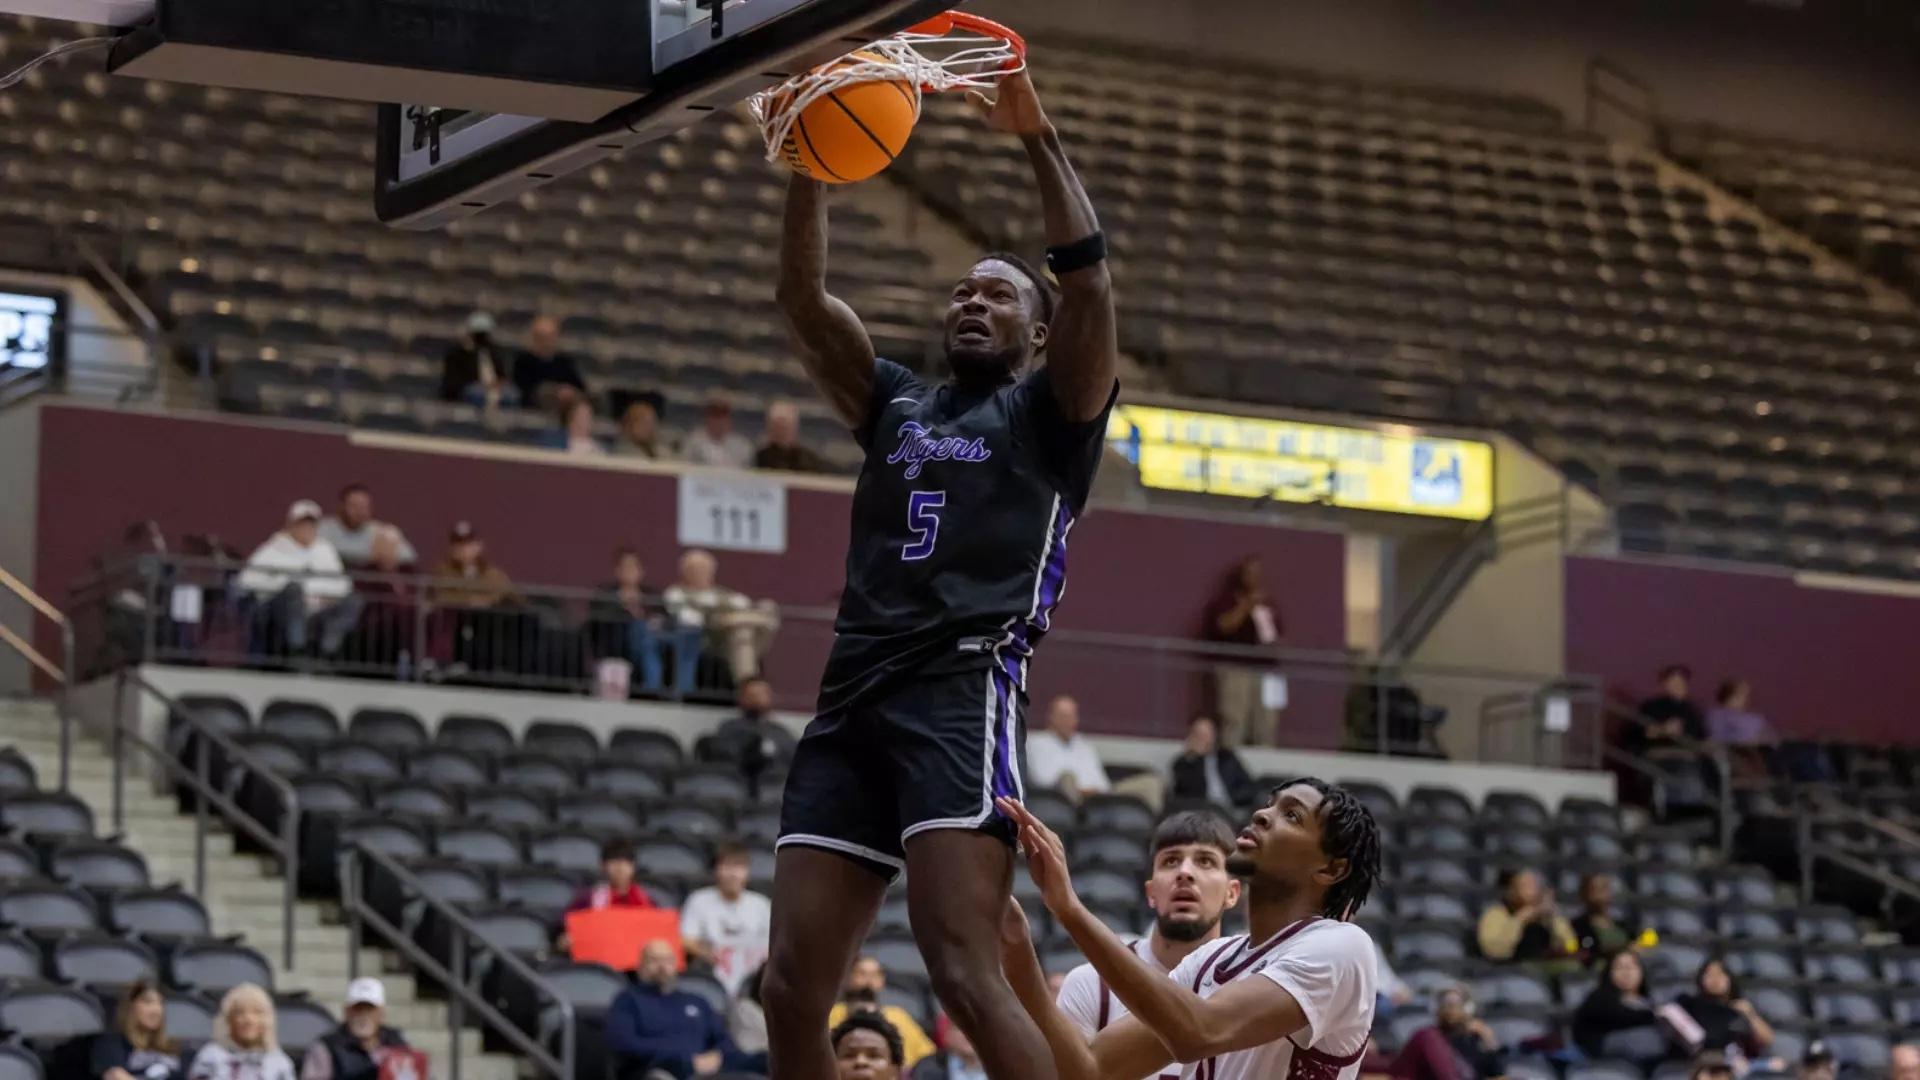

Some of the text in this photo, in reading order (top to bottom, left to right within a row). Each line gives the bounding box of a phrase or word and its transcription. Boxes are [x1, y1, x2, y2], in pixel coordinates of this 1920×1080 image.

[887, 421, 992, 480] Tigers
[709, 504, 761, 541] 111
[901, 490, 946, 560] 5
